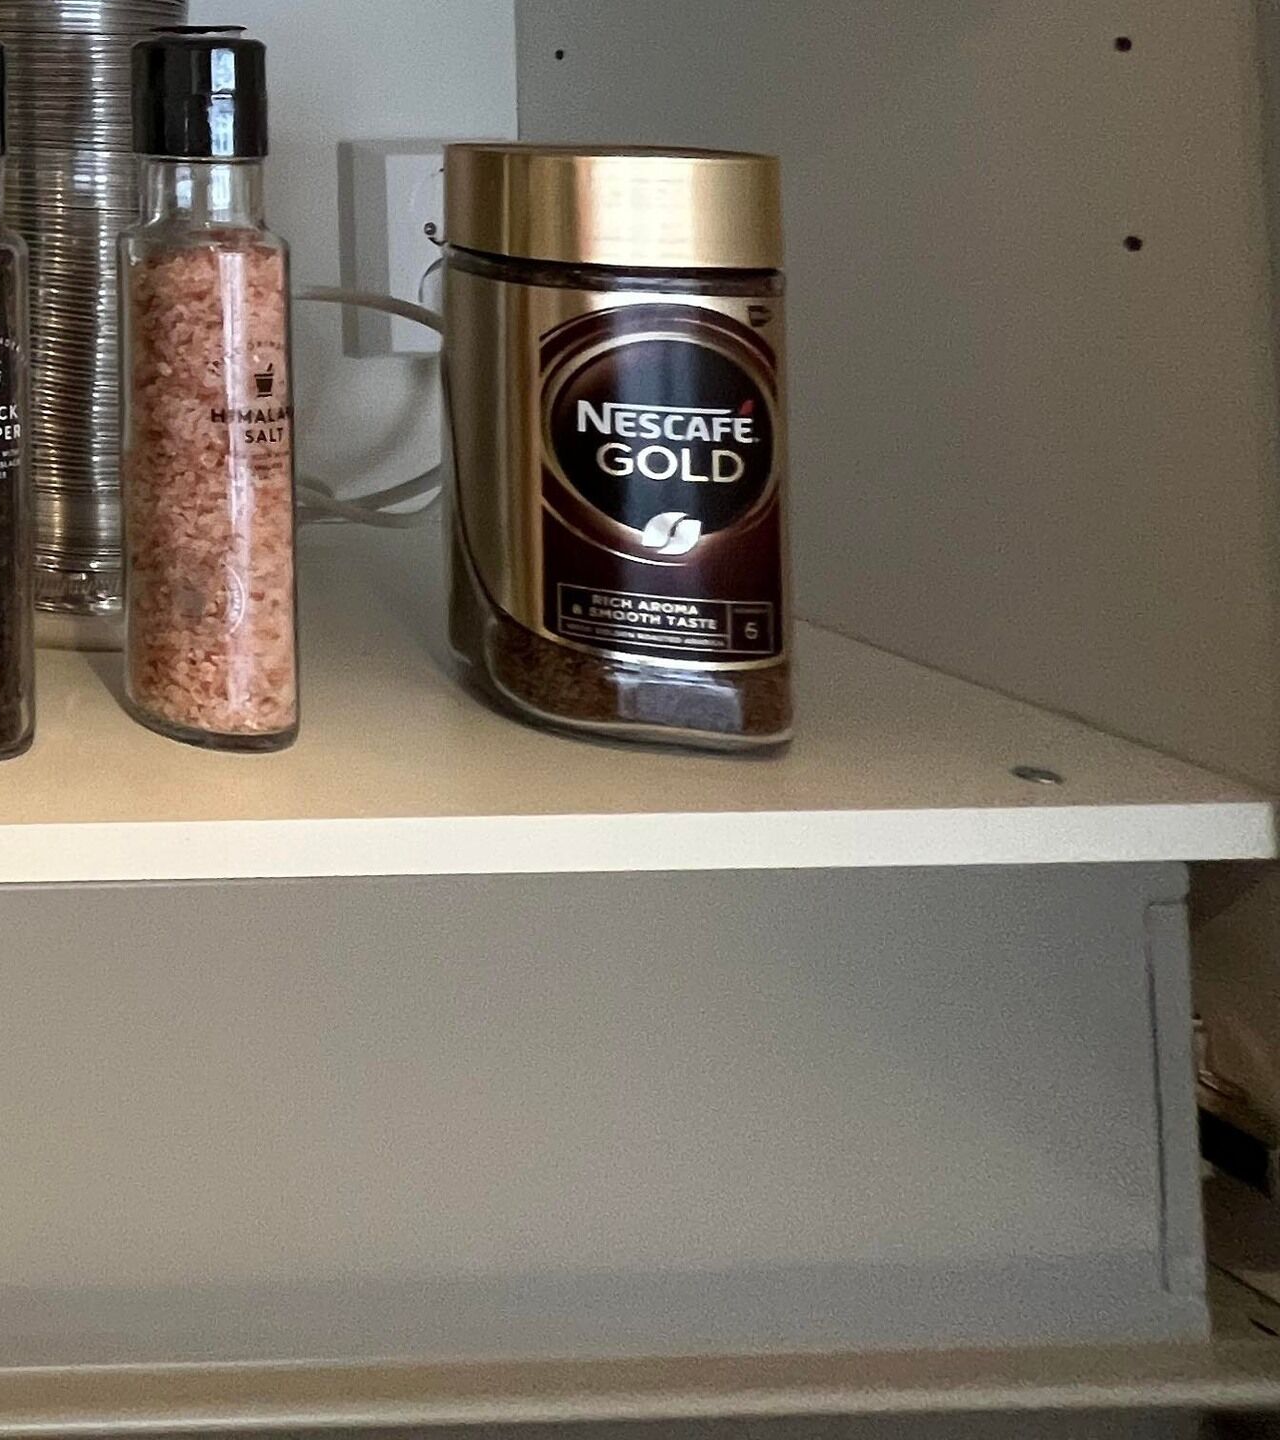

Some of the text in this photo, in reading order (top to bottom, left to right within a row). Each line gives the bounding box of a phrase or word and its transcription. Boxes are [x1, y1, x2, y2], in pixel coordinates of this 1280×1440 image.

[244, 427, 283, 444] SALT
[596, 441, 745, 483] GOLD
[591, 594, 699, 615] RICH AROMA
[589, 606, 662, 625] SMOOTH
[665, 615, 718, 631] TASTE
